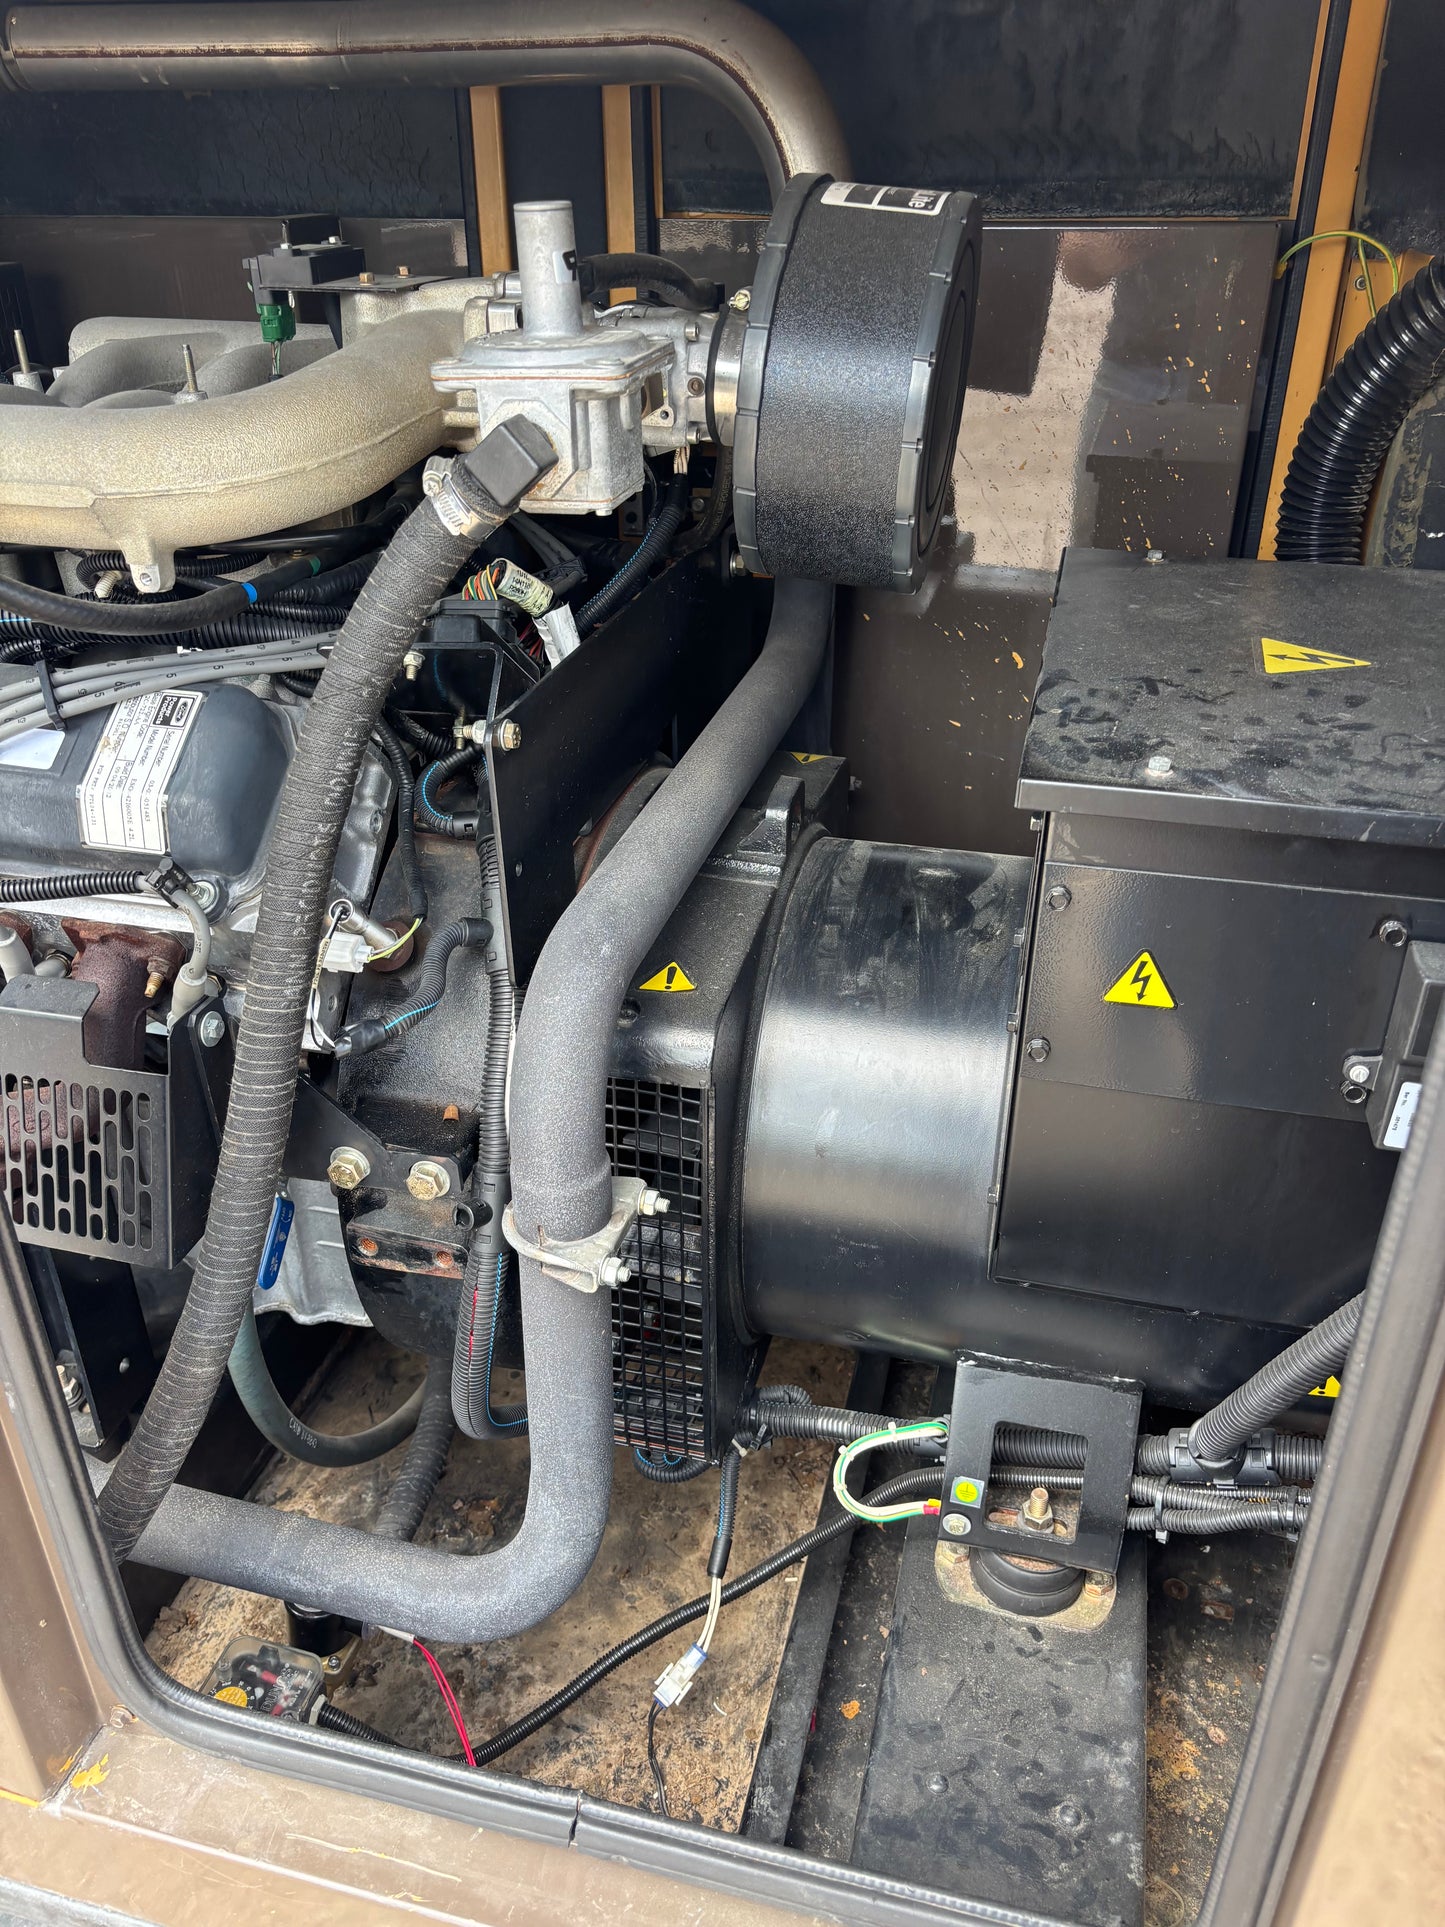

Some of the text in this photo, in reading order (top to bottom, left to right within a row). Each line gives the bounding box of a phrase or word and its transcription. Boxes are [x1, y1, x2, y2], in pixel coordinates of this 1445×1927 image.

[156, 696, 173, 724] Products
[164, 696, 178, 717] Power
[176, 701, 189, 723] Ford
[147, 729, 160, 745] Model
[163, 730, 175, 747] Serial
